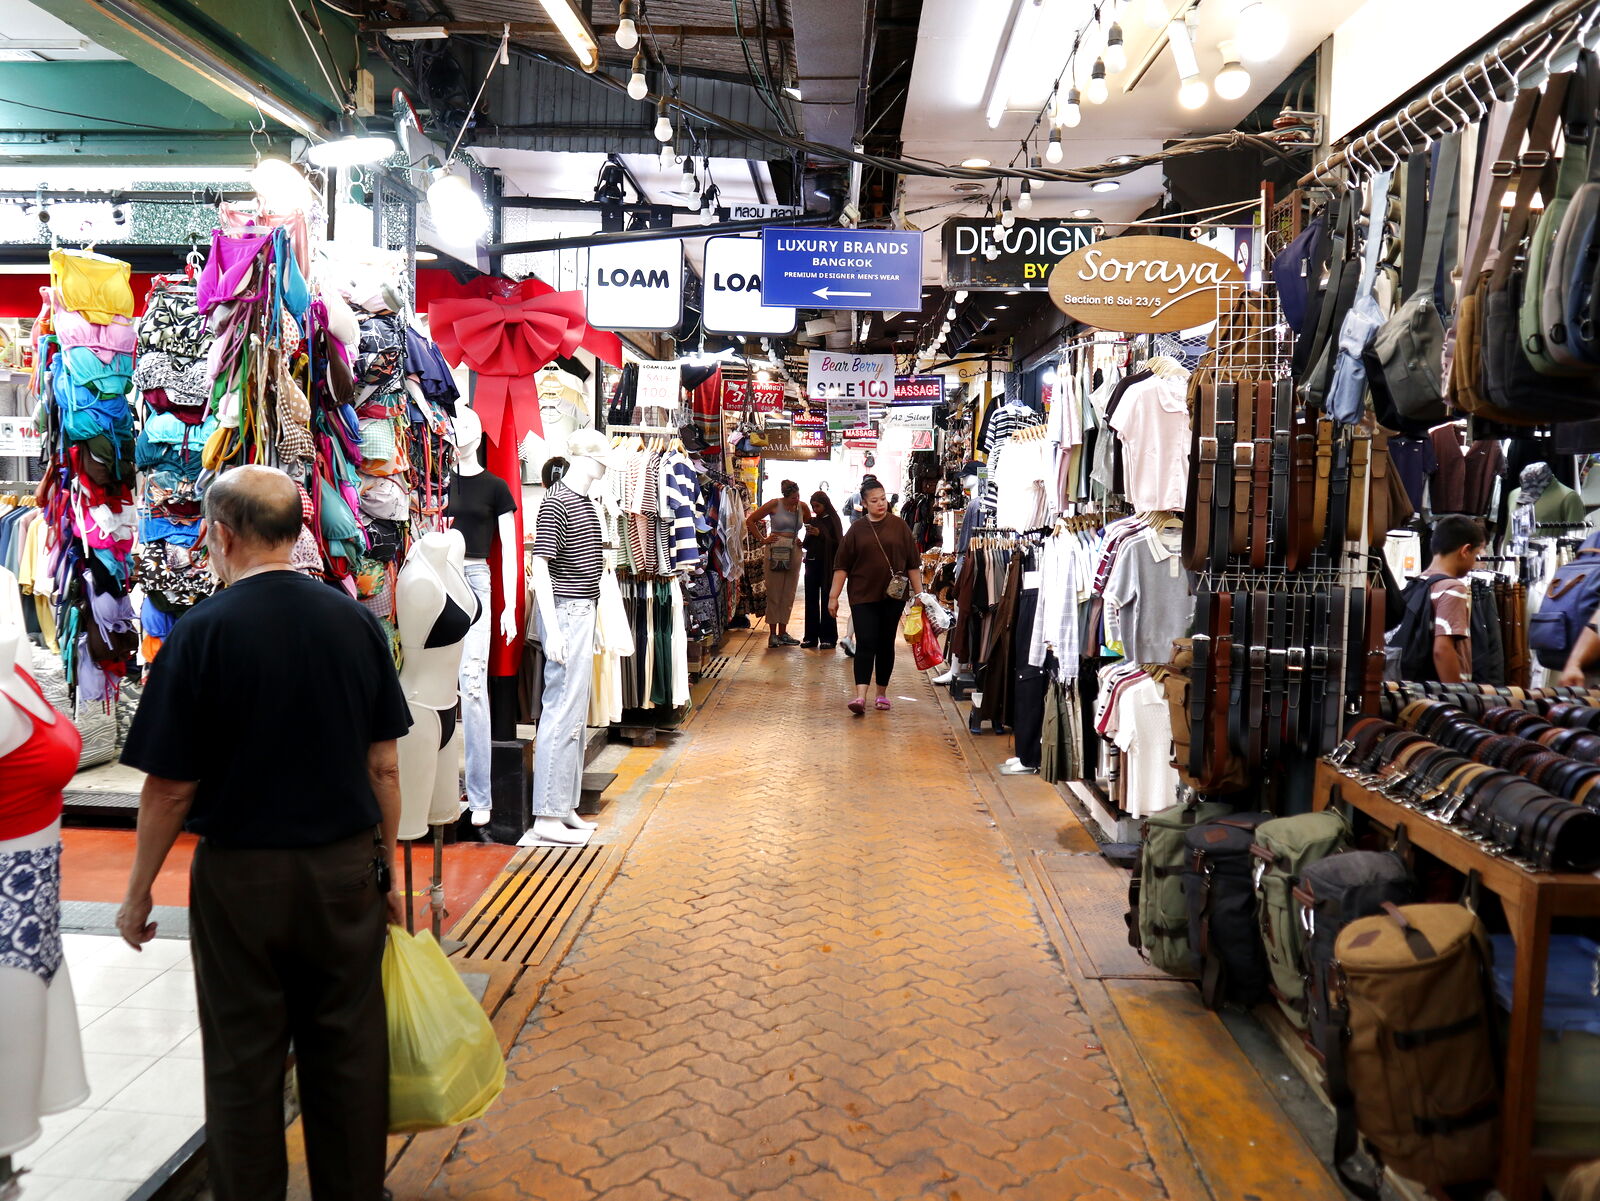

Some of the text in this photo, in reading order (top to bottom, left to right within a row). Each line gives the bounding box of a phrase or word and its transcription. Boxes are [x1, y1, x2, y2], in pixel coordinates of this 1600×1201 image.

[777, 239, 909, 255] LUXURY BRANDS
[812, 257, 873, 268] BANGKOK
[597, 268, 669, 289] LOAM
[784, 271, 817, 279] PREMIUM
[818, 272, 855, 280] DESIGNER
[1024, 263, 1048, 279] BY
[1078, 249, 1231, 294] Soraya
[714, 272, 761, 292] LOA
[1064, 294, 1162, 307] Section 16 Soi 23/5
[821, 356, 884, 379] Bear Berry
[817, 382, 855, 397] SALE
[859, 380, 888, 397] 100
[894, 385, 940, 396] MASSAGE
[891, 412, 931, 423] A2 Silver
[845, 429, 877, 437] MASSAGE
